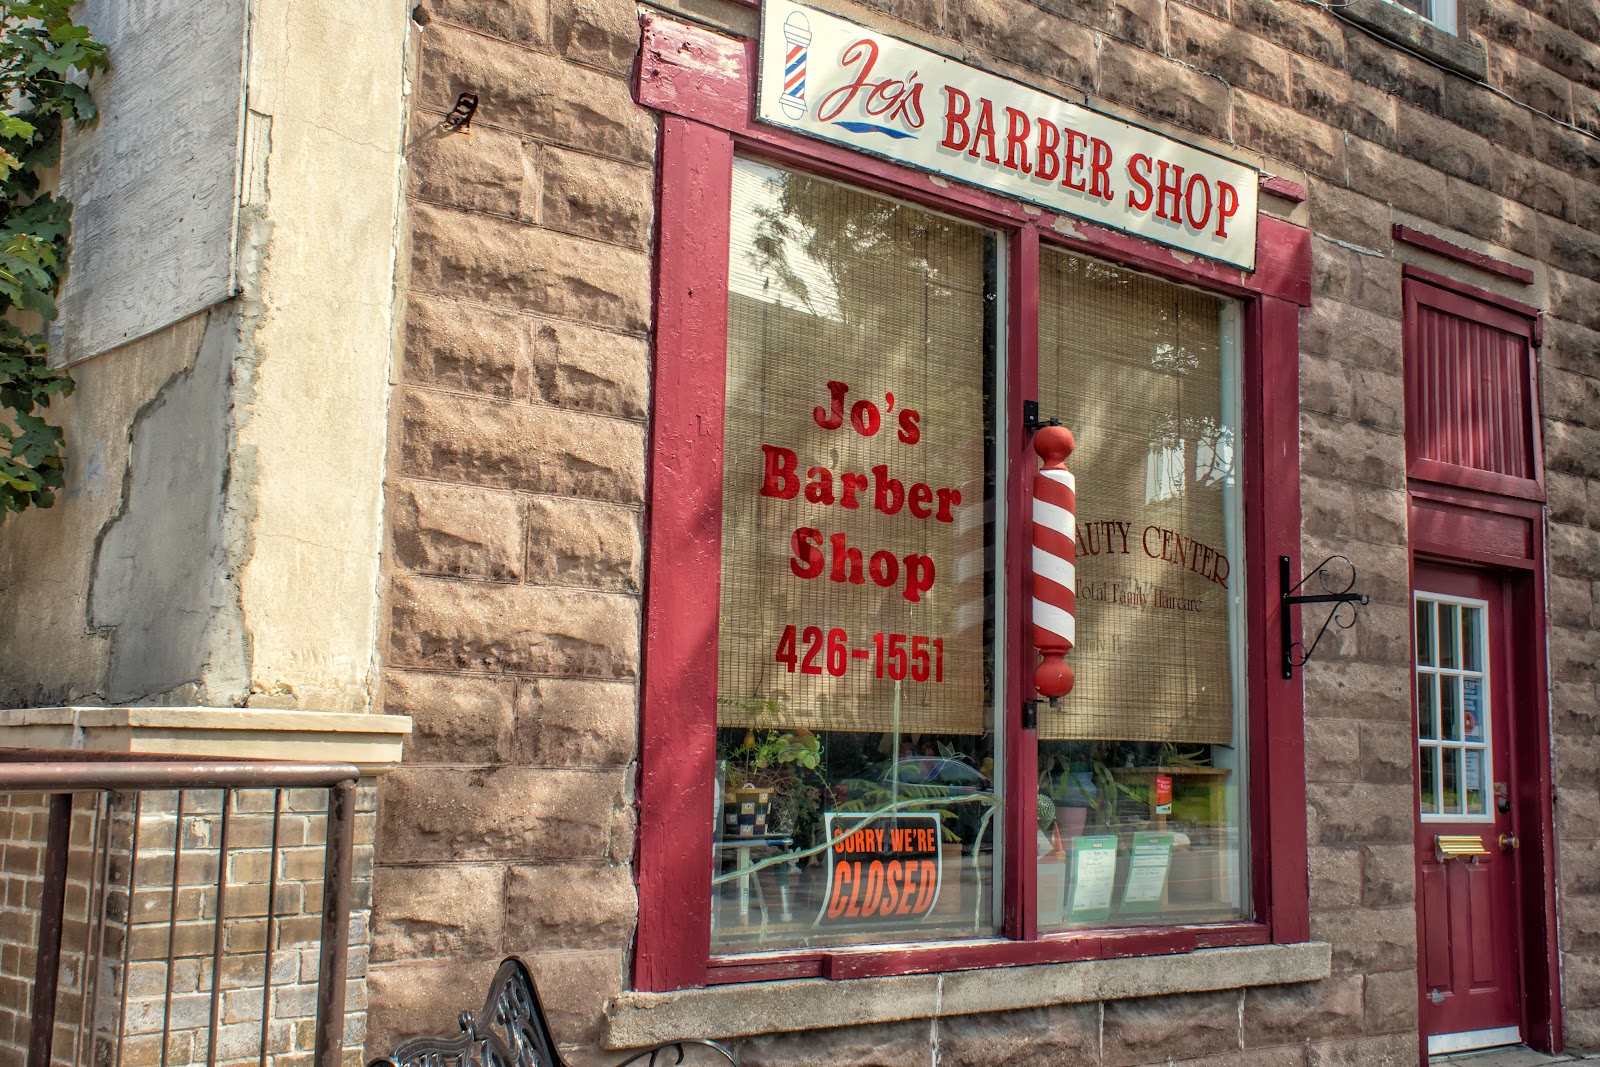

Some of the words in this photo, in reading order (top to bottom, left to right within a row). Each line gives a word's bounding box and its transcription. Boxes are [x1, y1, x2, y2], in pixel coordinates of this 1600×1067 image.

[818, 38, 925, 128] Jo's
[941, 85, 1115, 201] BARBER
[1127, 152, 1240, 239] SHOP
[812, 380, 921, 445] Jo's
[760, 443, 962, 523] Barber
[789, 526, 936, 603] Shop
[1142, 525, 1231, 590] CENTER
[1112, 583, 1149, 613] Family
[1153, 587, 1203, 613] Haircare
[775, 624, 944, 683] 426-1551
[833, 828, 885, 854] SORRY
[890, 828, 936, 853] WE'RE
[827, 859, 937, 919] CLOSED
